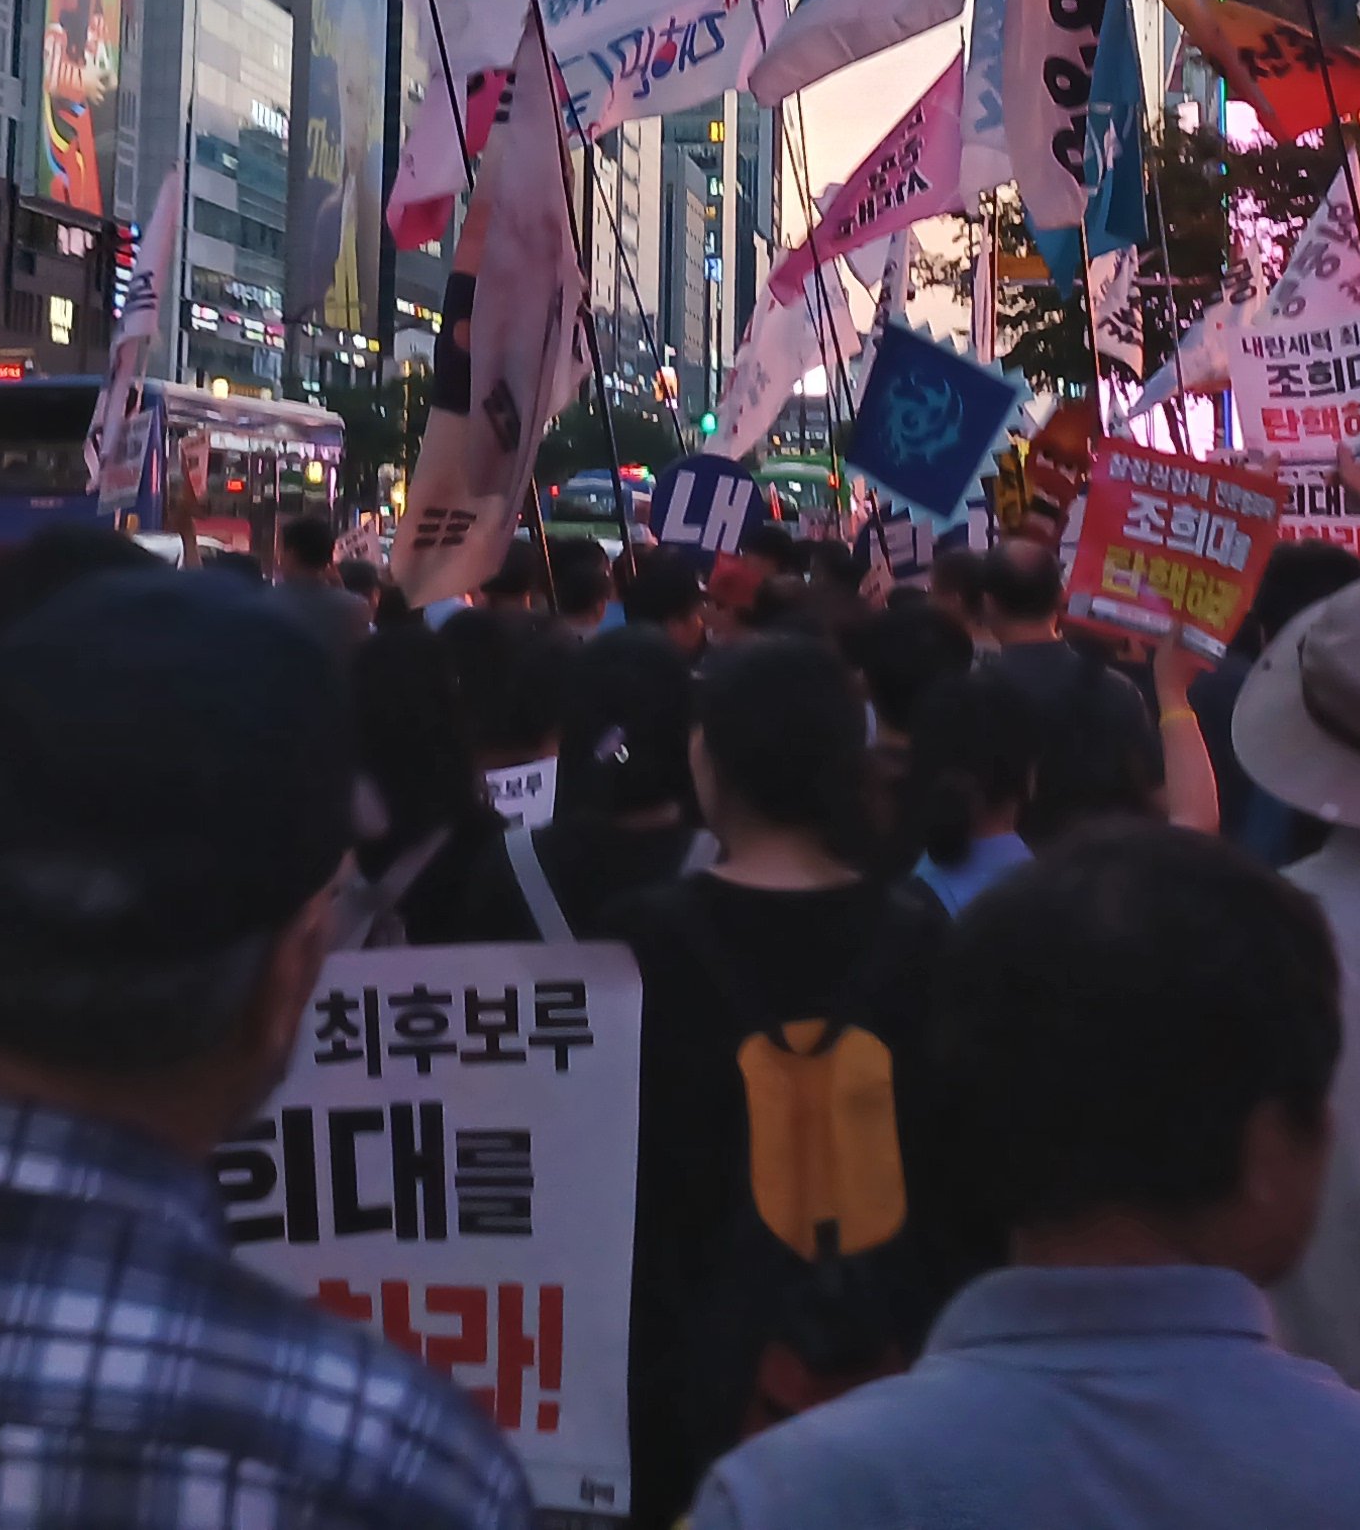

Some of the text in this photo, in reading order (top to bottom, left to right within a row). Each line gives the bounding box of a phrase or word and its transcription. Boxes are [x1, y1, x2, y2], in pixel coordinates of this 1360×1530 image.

[1242, 328, 1333, 359] 내란세력
[314, 978, 595, 1080] 최후보루
[212, 1100, 536, 1245] 희대를
